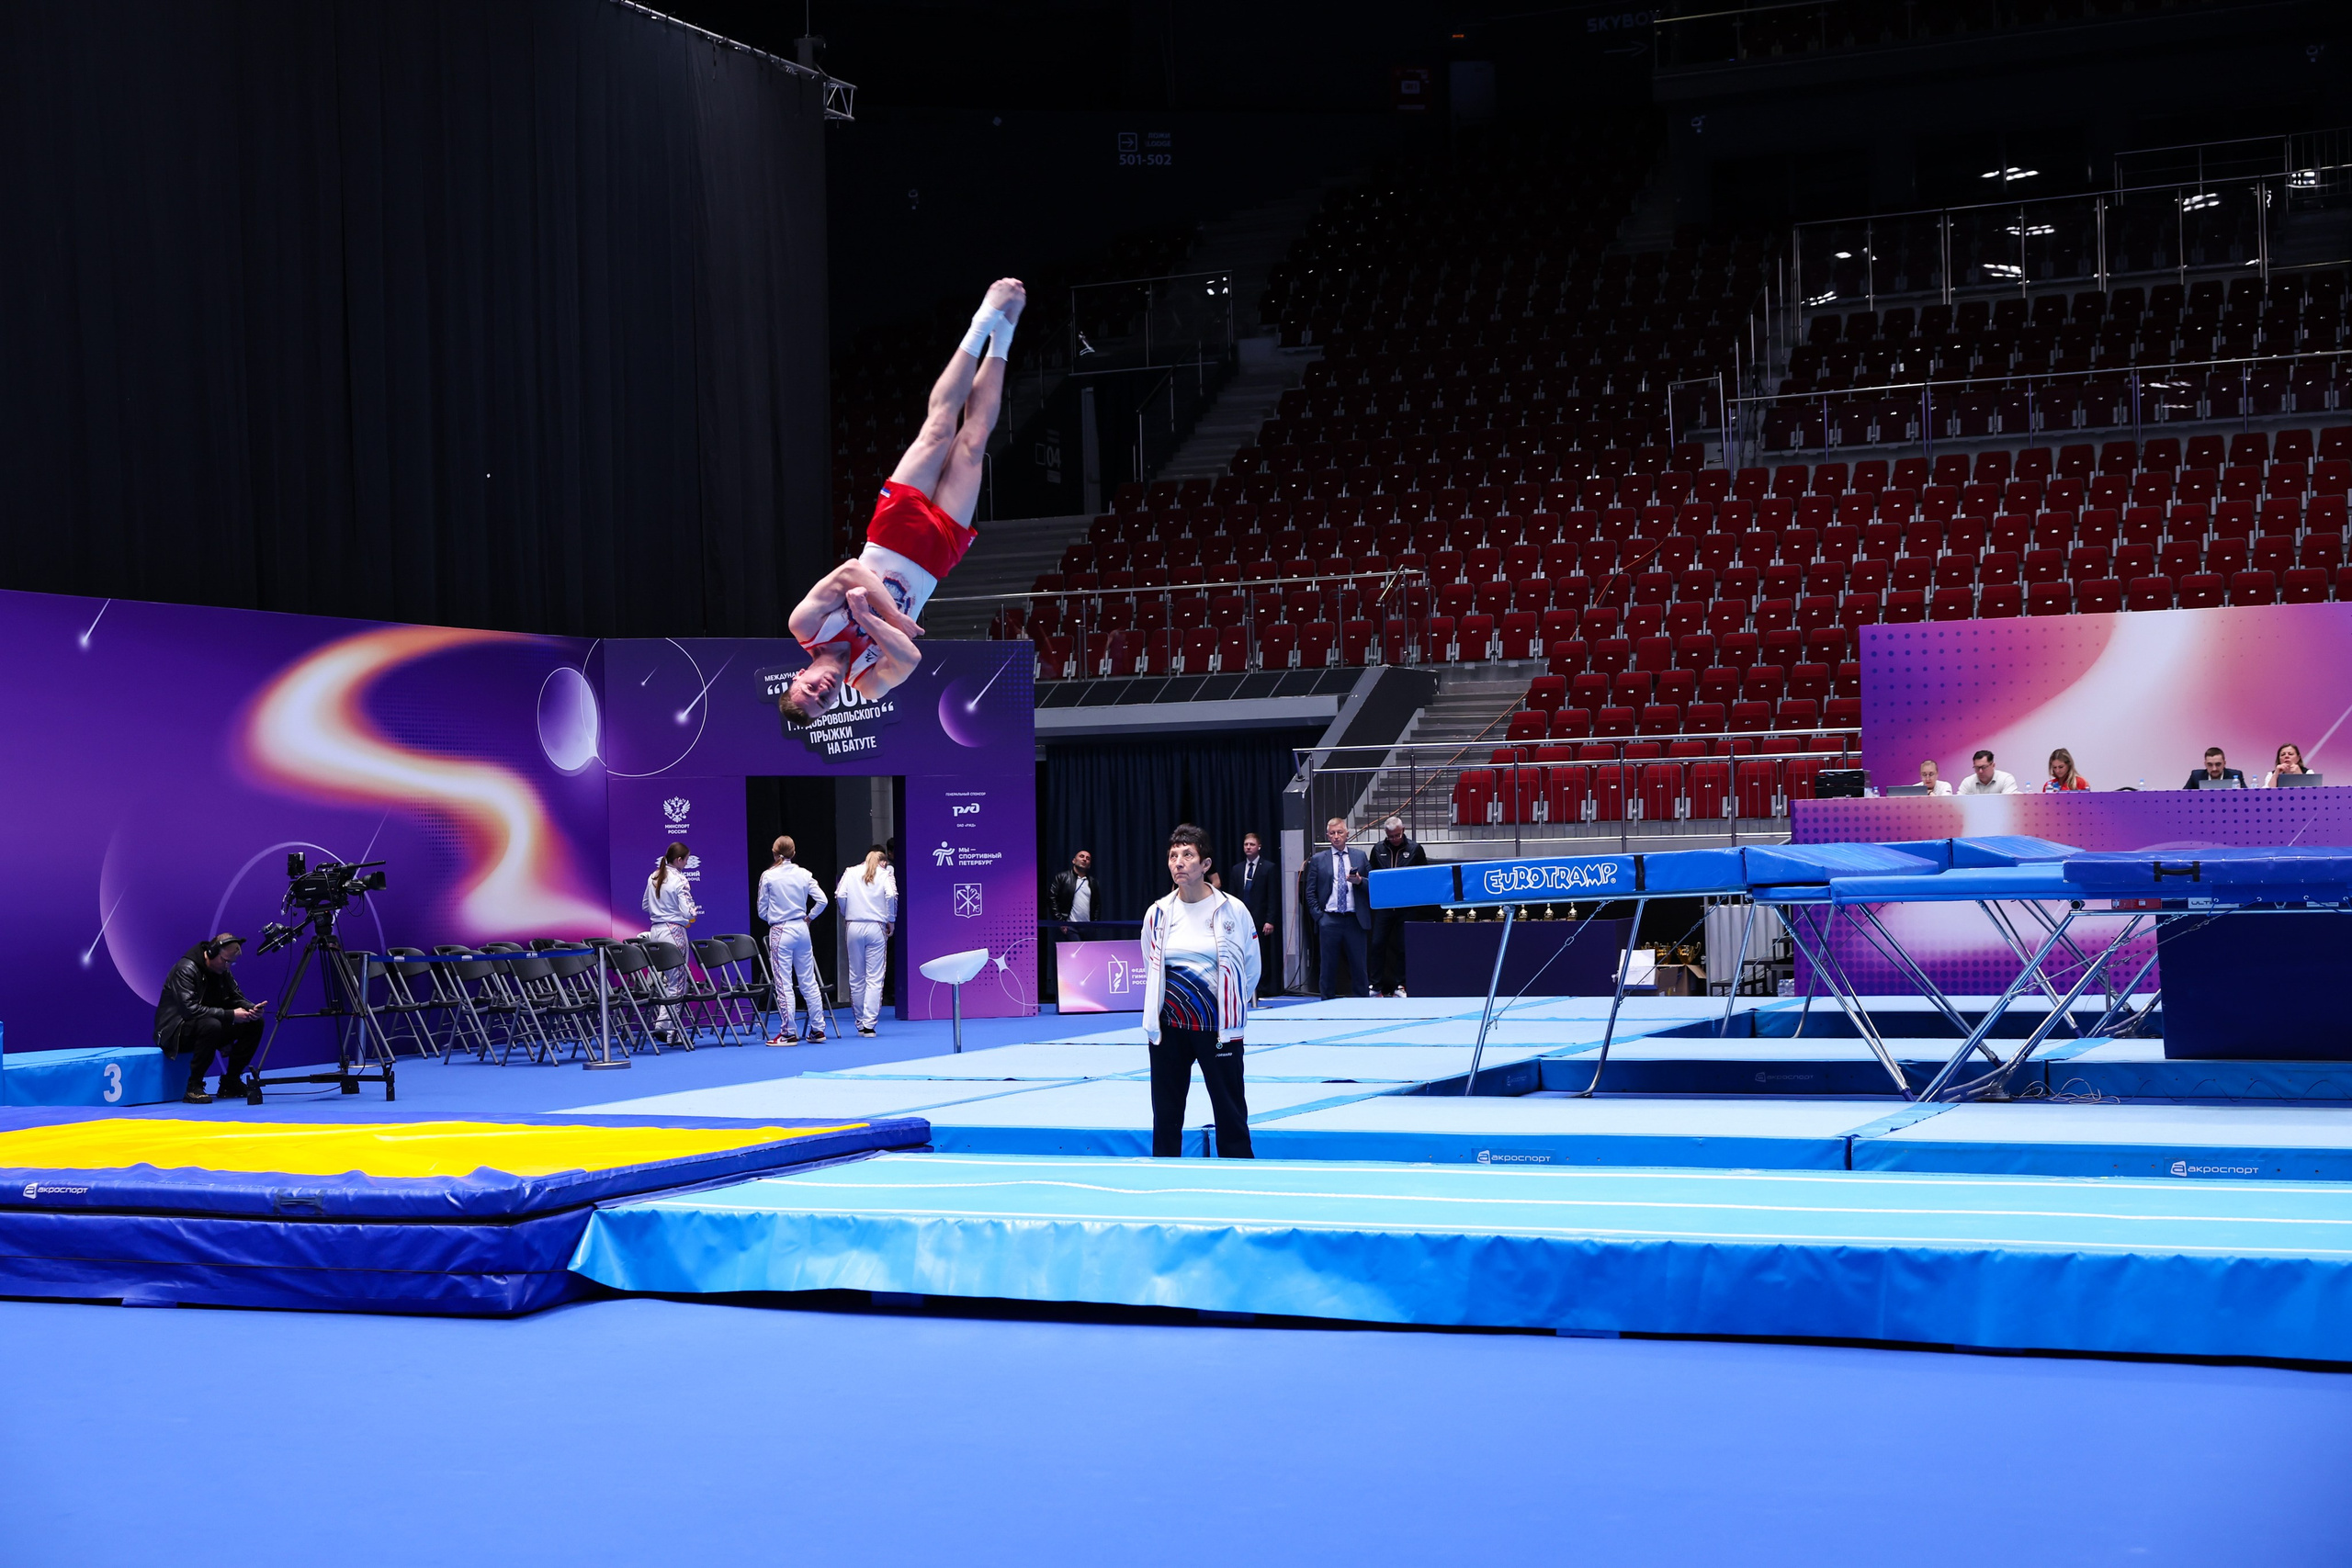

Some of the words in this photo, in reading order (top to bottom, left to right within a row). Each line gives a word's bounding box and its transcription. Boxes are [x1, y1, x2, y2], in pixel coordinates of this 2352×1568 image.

[1118, 153, 1172, 165] 501-502
[1046, 445, 1061, 468] 04
[809, 726, 854, 744] ПРЫЖКИ
[827, 740, 842, 755] НА
[842, 736, 877, 752] БАТУТЕ
[103, 1063, 122, 1102] 3
[1491, 1155, 1551, 1163] акроспорт
[2188, 1166, 2259, 1175] акроспорт
[37, 1186, 89, 1195] акроспорт
